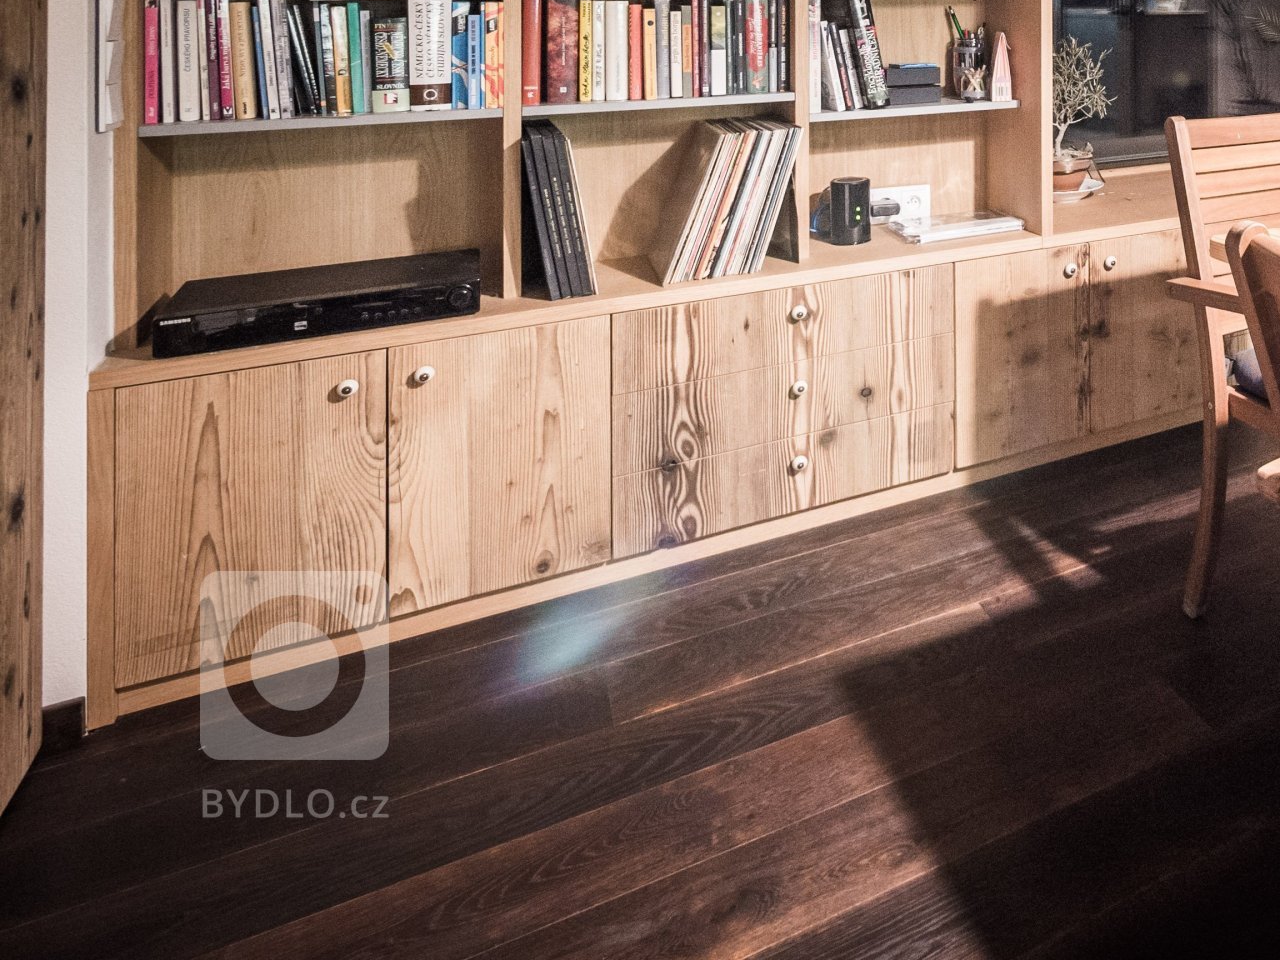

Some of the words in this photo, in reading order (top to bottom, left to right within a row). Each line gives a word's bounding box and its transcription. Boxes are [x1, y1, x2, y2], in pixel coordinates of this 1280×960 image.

[182, 7, 194, 42] PRAVOPISU
[414, 1, 425, 79] NĚMECKO-ČESKÝ
[182, 43, 195, 73] ČESKÉHO
[159, 317, 192, 327] SAMSUNG
